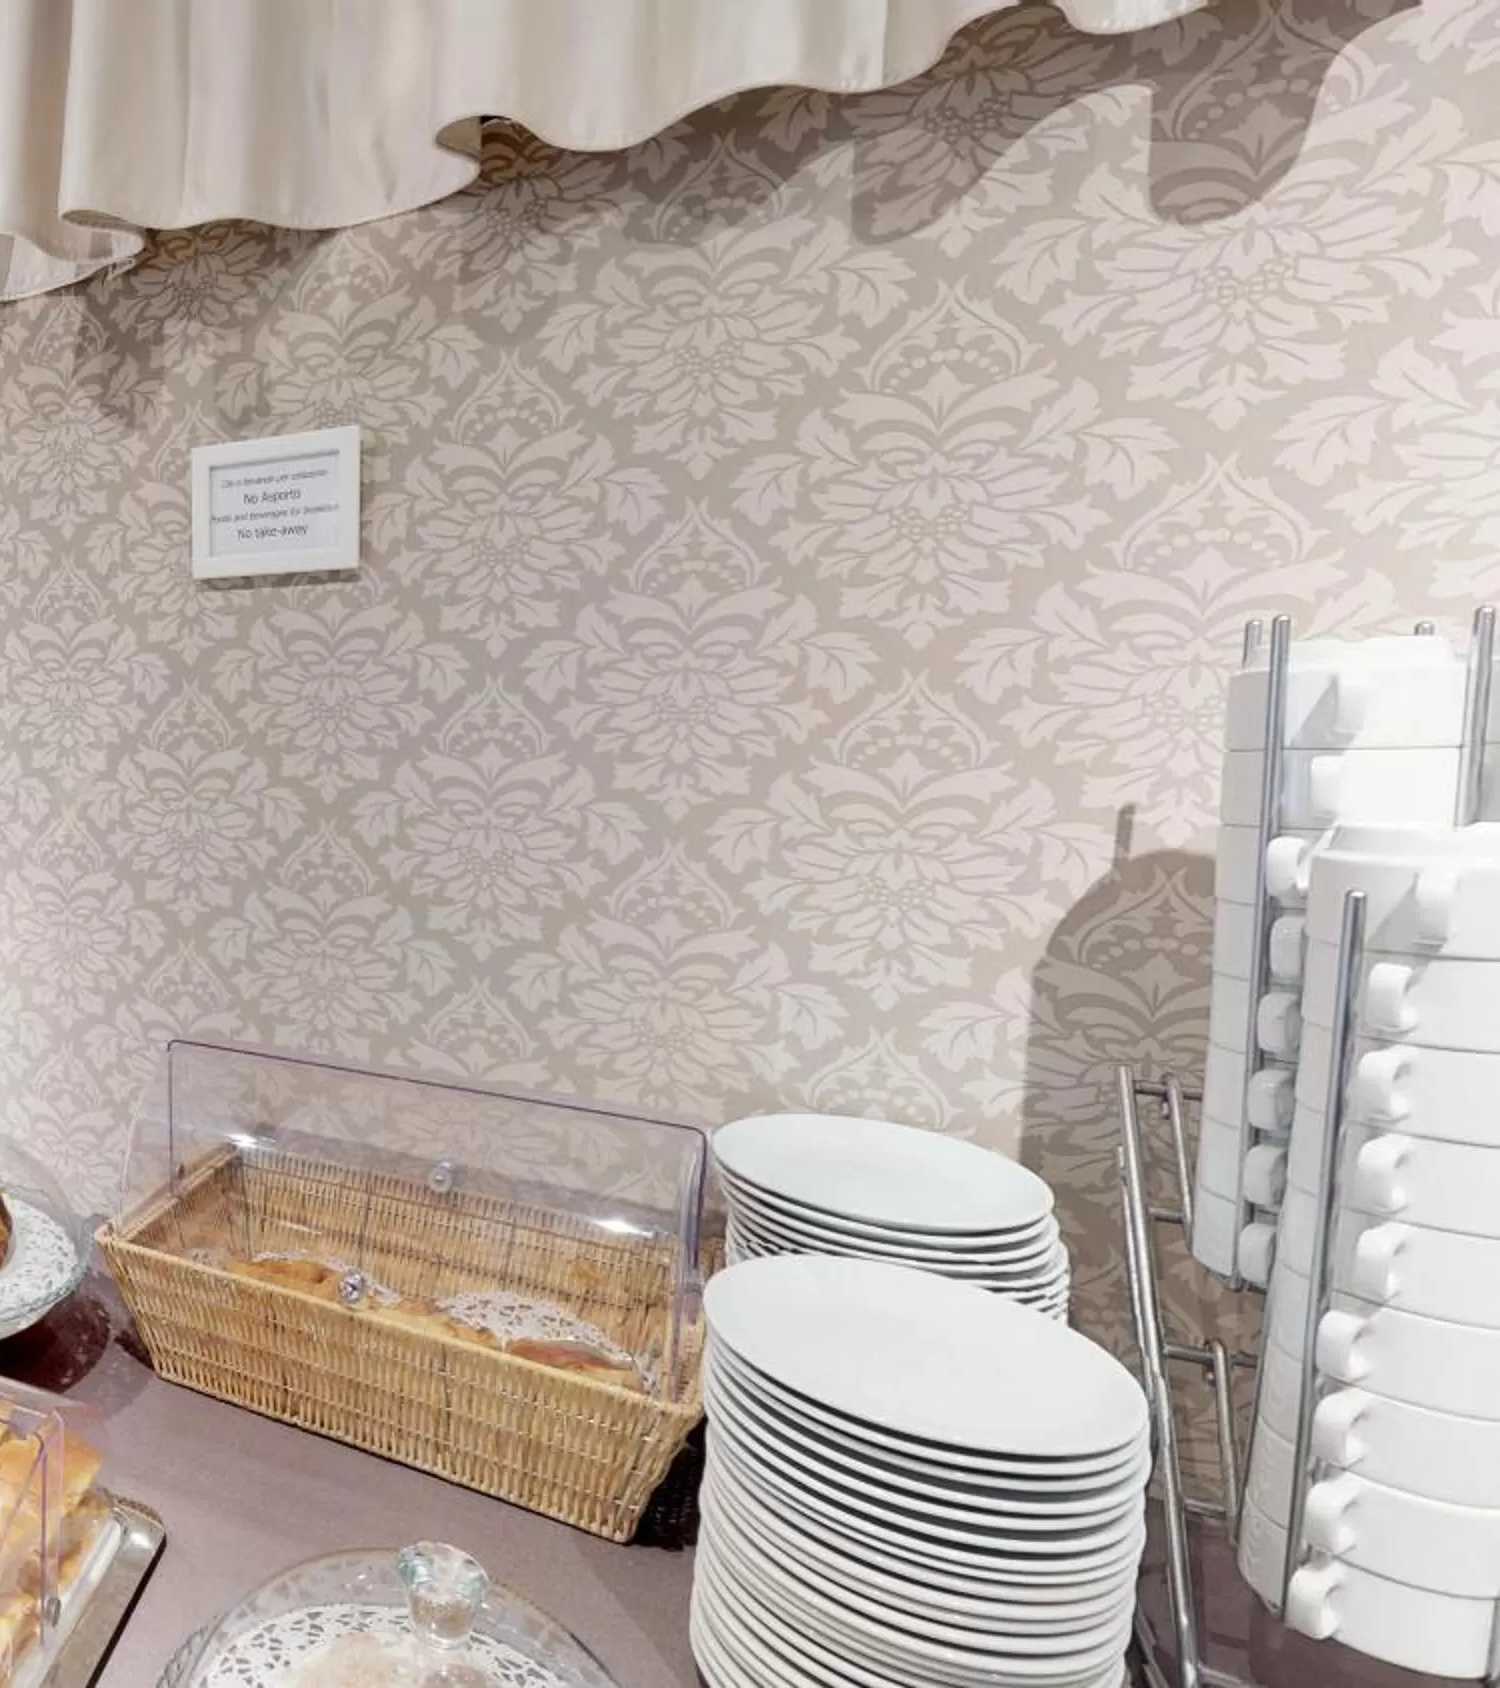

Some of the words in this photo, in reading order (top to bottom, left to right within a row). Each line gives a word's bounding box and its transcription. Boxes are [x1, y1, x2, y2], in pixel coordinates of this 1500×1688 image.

[243, 493, 259, 505] No
[260, 489, 301, 504] Asporto
[237, 529, 252, 541] No
